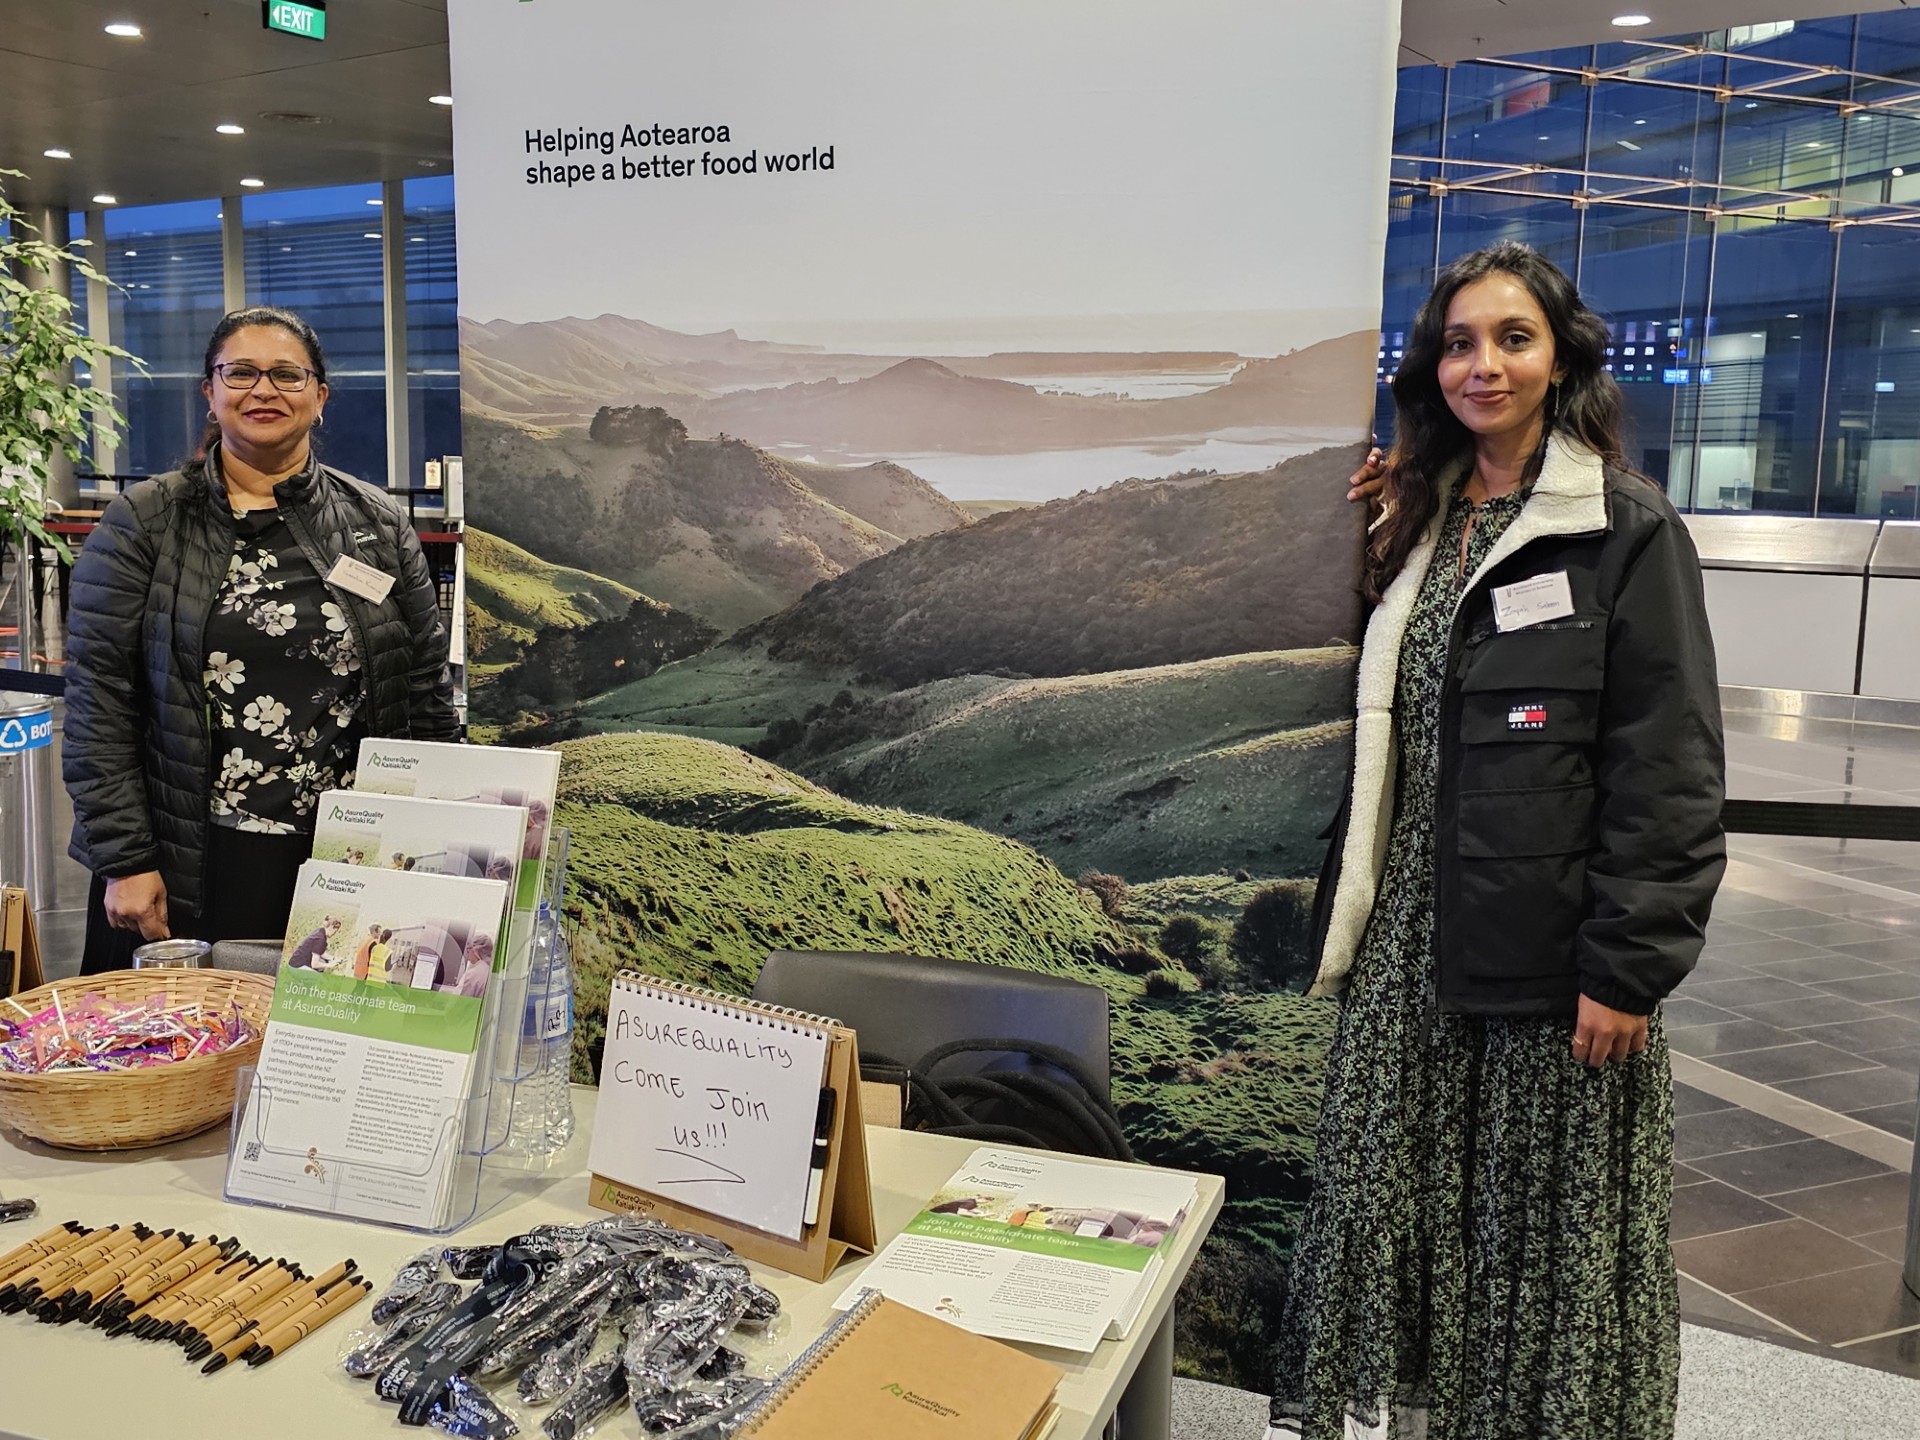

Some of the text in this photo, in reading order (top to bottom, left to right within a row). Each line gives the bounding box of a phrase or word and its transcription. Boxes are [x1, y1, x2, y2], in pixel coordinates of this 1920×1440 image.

[281, 5, 314, 32] EXIT
[525, 123, 731, 155] Helping Aotearoa
[526, 145, 835, 188] shape a better food world
[382, 756, 419, 765] AsureQuality
[344, 816, 365, 824] Kaitiaki
[345, 809, 384, 819] AsureQuality
[326, 884, 346, 893] Kaitiaki
[327, 877, 366, 889] AsureQuality
[285, 982, 416, 1014] Join the passionate team
[282, 999, 361, 1024] at AsureQuality
[616, 1191, 655, 1210] AsureQuality
[918, 1224, 932, 1232] at
[932, 1226, 1015, 1245] AsureQuality
[923, 1217, 1079, 1247] Join the passionate team
[382, 1357, 411, 1396] reQuality
[902, 1395, 948, 1417] Kaitiaki Kai
[905, 1391, 961, 1418] AsureQuality
